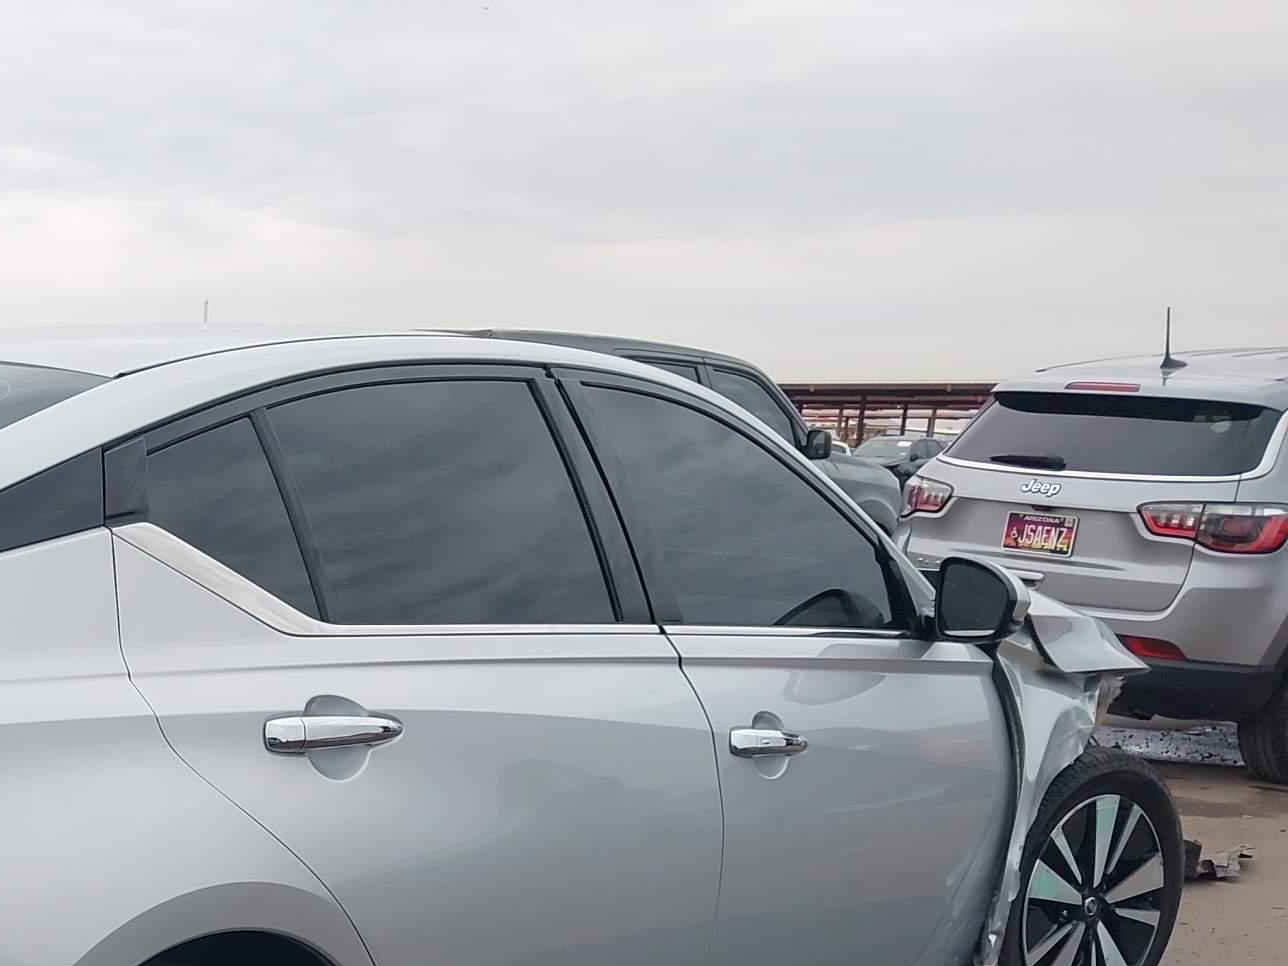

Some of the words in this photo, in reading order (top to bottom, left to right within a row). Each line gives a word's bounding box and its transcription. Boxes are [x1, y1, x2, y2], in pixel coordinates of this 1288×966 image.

[1021, 479, 1062, 498] Jeep
[1023, 514, 1061, 524] ARIZONA
[1017, 524, 1068, 550] JSAENZ
